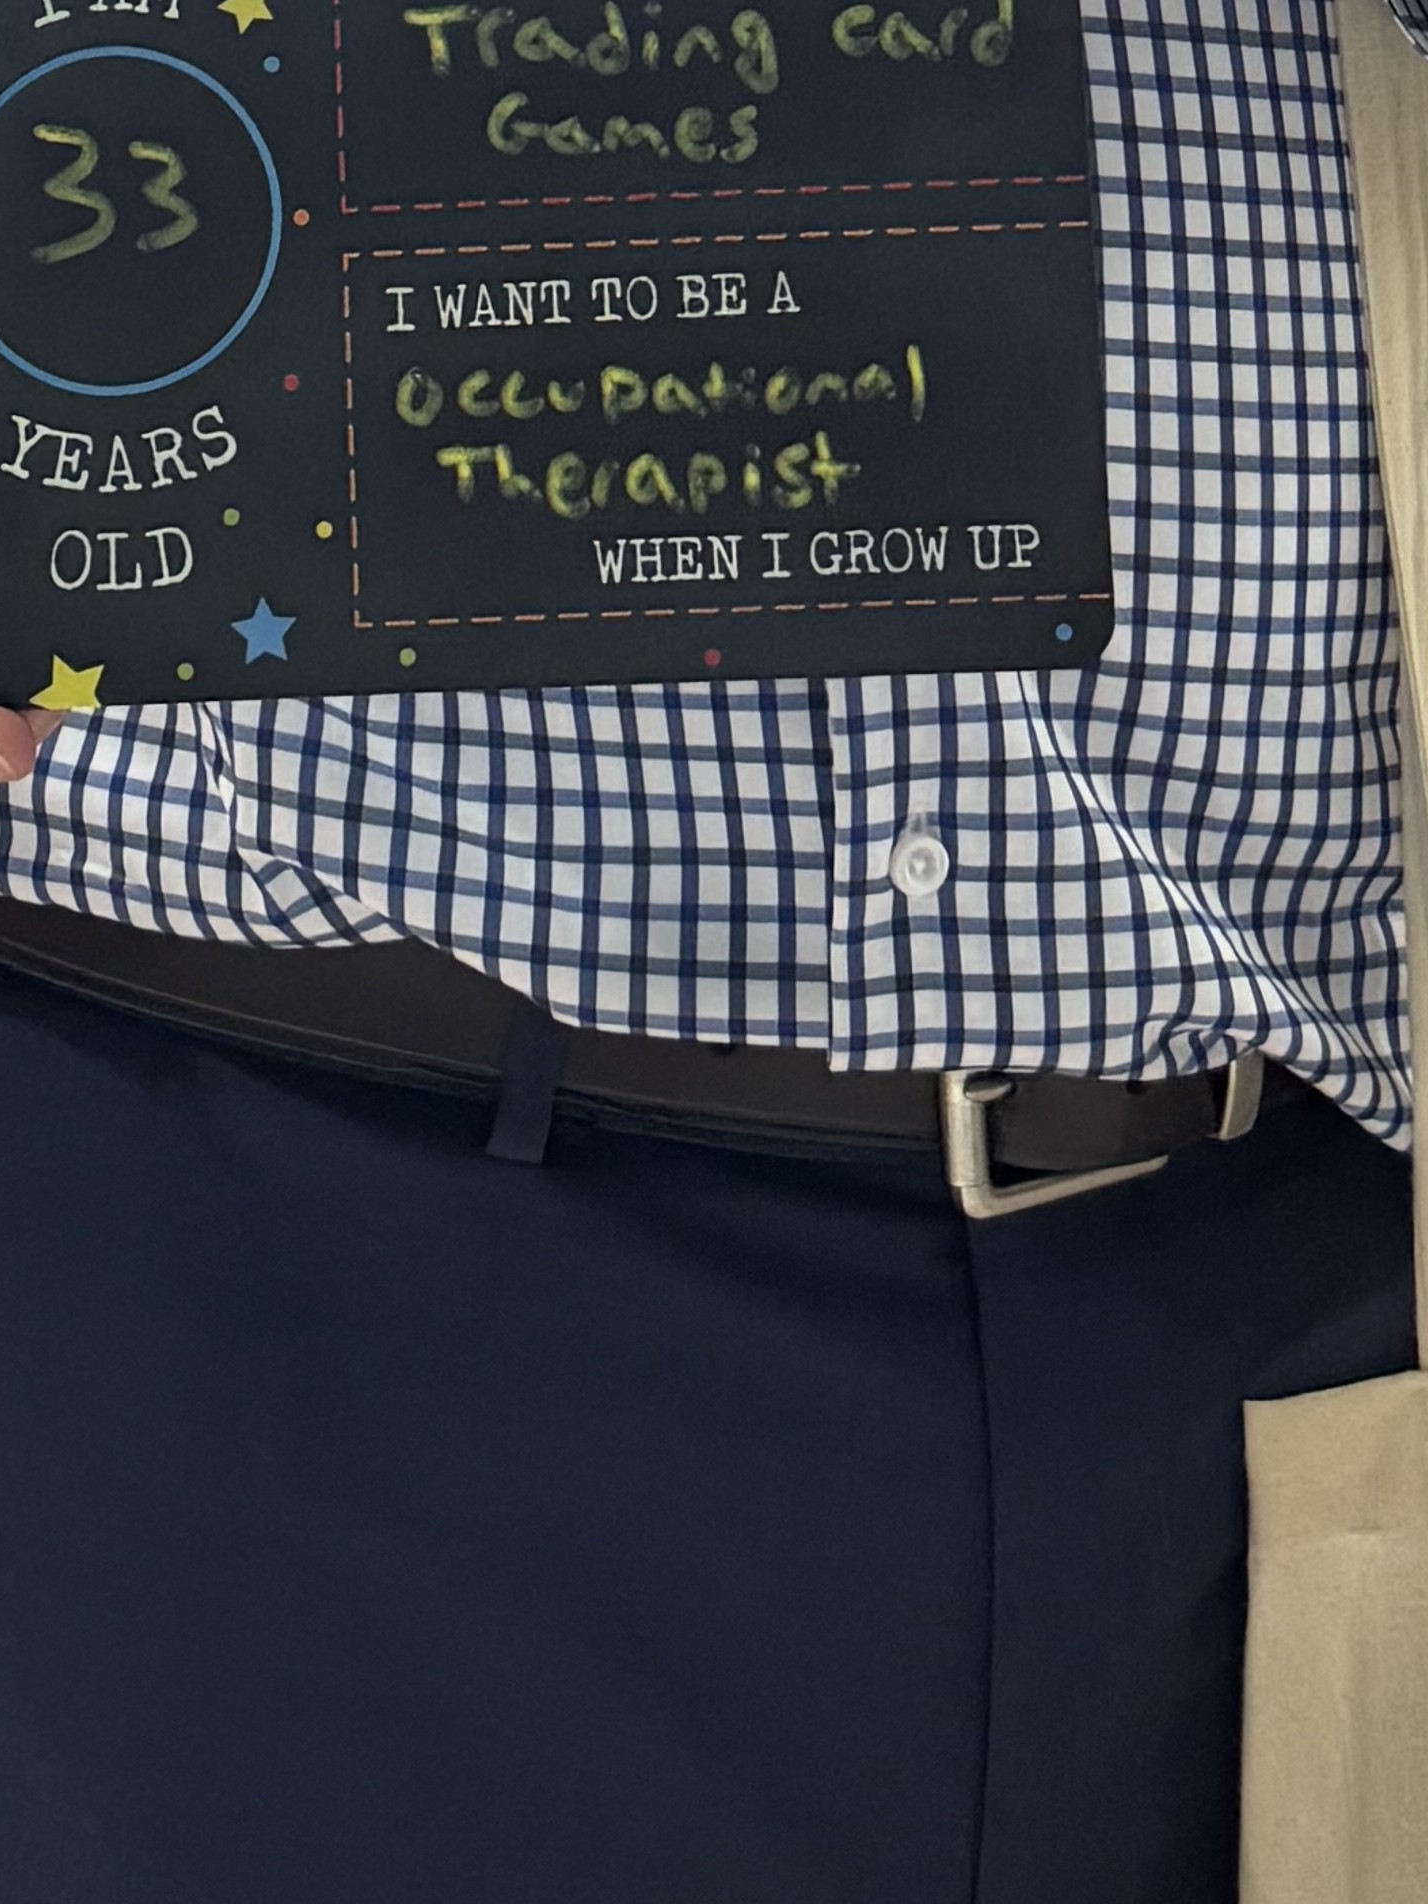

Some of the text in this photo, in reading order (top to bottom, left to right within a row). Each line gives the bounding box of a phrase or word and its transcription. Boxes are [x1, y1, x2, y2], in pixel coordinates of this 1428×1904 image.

[403, 0, 779, 94] Trading
[486, 92, 758, 163] Games
[29, 124, 199, 264] 33
[385, 269, 801, 332] I WANT TO BE A
[0, 405, 237, 493] YEARS
[436, 430, 862, 517] Therapist
[50, 527, 194, 590] OLD
[593, 524, 1041, 584] WHEN I GROW UP
